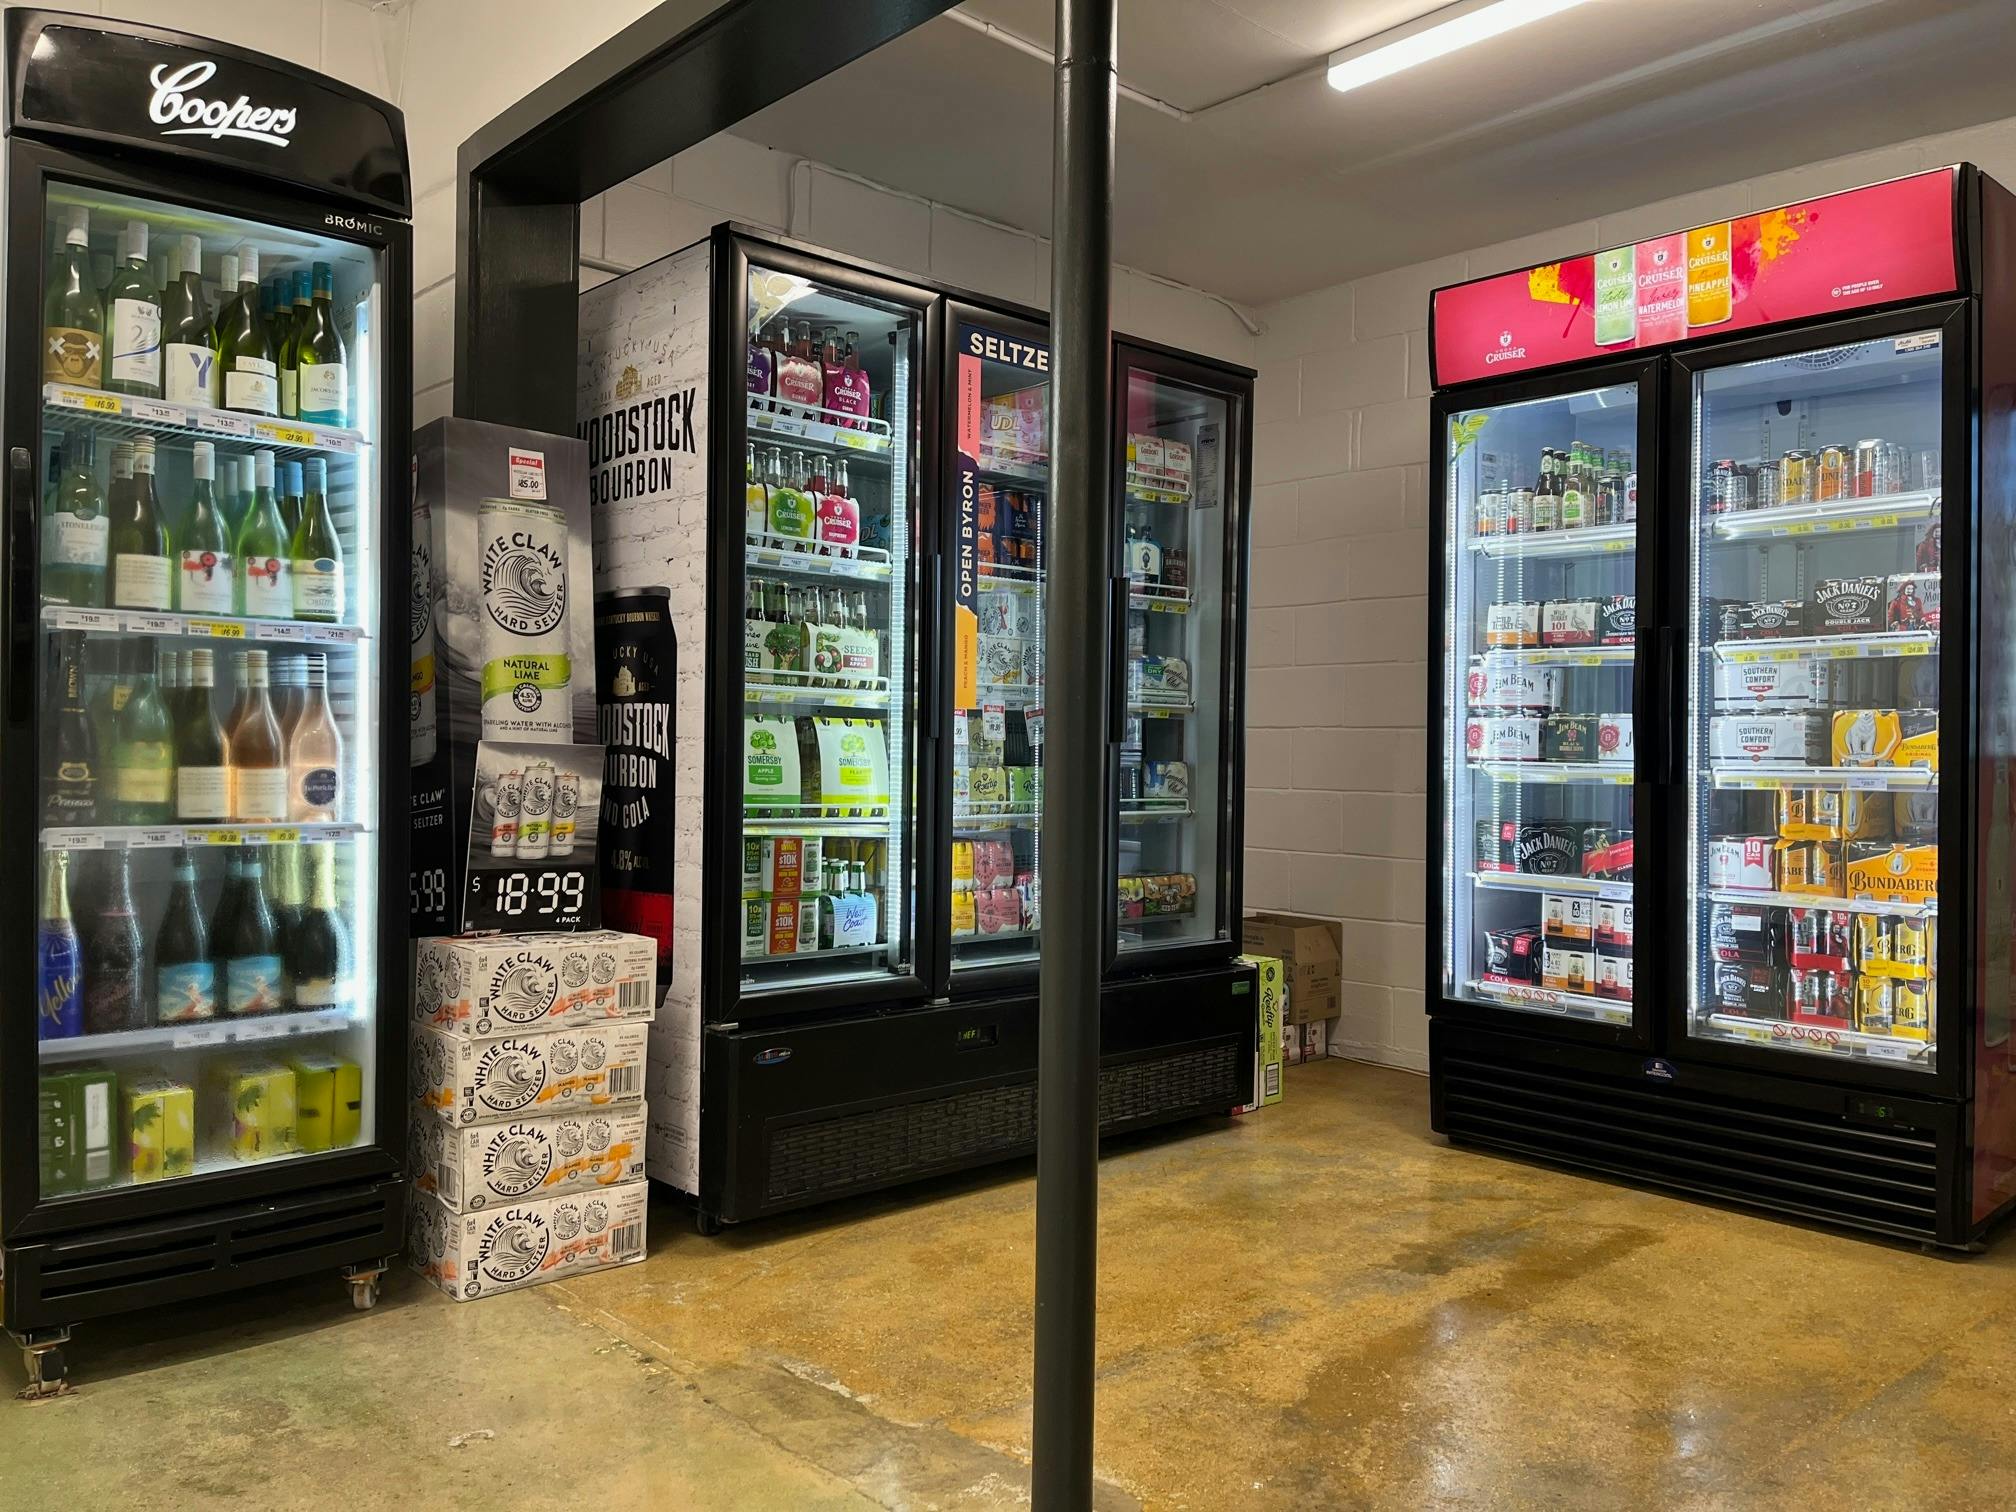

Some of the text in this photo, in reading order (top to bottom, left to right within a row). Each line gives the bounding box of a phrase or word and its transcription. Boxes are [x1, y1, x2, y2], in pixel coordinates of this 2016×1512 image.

[149, 61, 297, 147] Coopers
[1689, 250, 1729, 269] CRUISER
[1597, 272, 1634, 290] CRUISER
[1638, 266, 1684, 288] CRUISER
[1689, 276, 1729, 294] PINEAPPLE
[1638, 298, 1685, 315] WATERMELON
[970, 332, 1049, 372] SELTZE
[1485, 346, 1527, 365] CRUISER
[190, 351, 213, 389] Y
[784, 377, 815, 392] CRUISER
[834, 386, 862, 401] CRUISER
[990, 415, 1022, 431] UDL
[590, 457, 672, 506] BOURBON
[823, 516, 852, 529] CRUISER
[961, 471, 974, 597] OPEN BYRON
[482, 532, 562, 596] WHITE CLAW
[1816, 581, 1881, 604] JACK DANIEL'S
[494, 583, 564, 630] HARD SELTZER
[1602, 600, 1622, 618] JACK
[1751, 607, 1767, 620] JACK
[1551, 622, 1566, 631] 101
[843, 645, 873, 655] SEEDS
[503, 659, 550, 671] NATURAL
[1743, 666, 1778, 676] SOUTHERN
[514, 670, 540, 681] LIME
[1510, 673, 1535, 692] BEAM
[1745, 674, 1775, 684] COMFORT
[510, 720, 533, 728] WATER
[599, 703, 670, 760] ODSTOCK
[1556, 720, 1587, 735] JIM BEAM
[1738, 727, 1774, 737] SOUTHERN
[1507, 725, 1530, 745] BEAM
[1740, 735, 1772, 744] COMFORT
[747, 755, 782, 765] SOMERSBY
[604, 753, 657, 789] OURBON
[622, 795, 650, 829] COLA
[413, 815, 444, 830] SELTZER
[1520, 832, 1578, 860] JACK DANIEL'S
[1745, 841, 1760, 853] 10
[779, 854, 797, 865] $10K
[471, 871, 585, 916] $ 18.99
[562, 915, 581, 924] PACK
[775, 917, 794, 927] $10K
[1720, 950, 1740, 958] OLA
[490, 951, 554, 1001] WHITE CLAW
[1490, 975, 1510, 983] COLA
[501, 981, 555, 1021] HARD SELTZER
[475, 1039, 542, 1091] WHITE CLAW
[486, 1068, 543, 1109] HARD SELTZER
[483, 1123, 548, 1177] WHITE CLAW
[494, 1152, 549, 1194] HARD SELTZER
[479, 1208, 545, 1263] WHITE CLAW
[490, 1236, 546, 1279] HARD SELTZER
